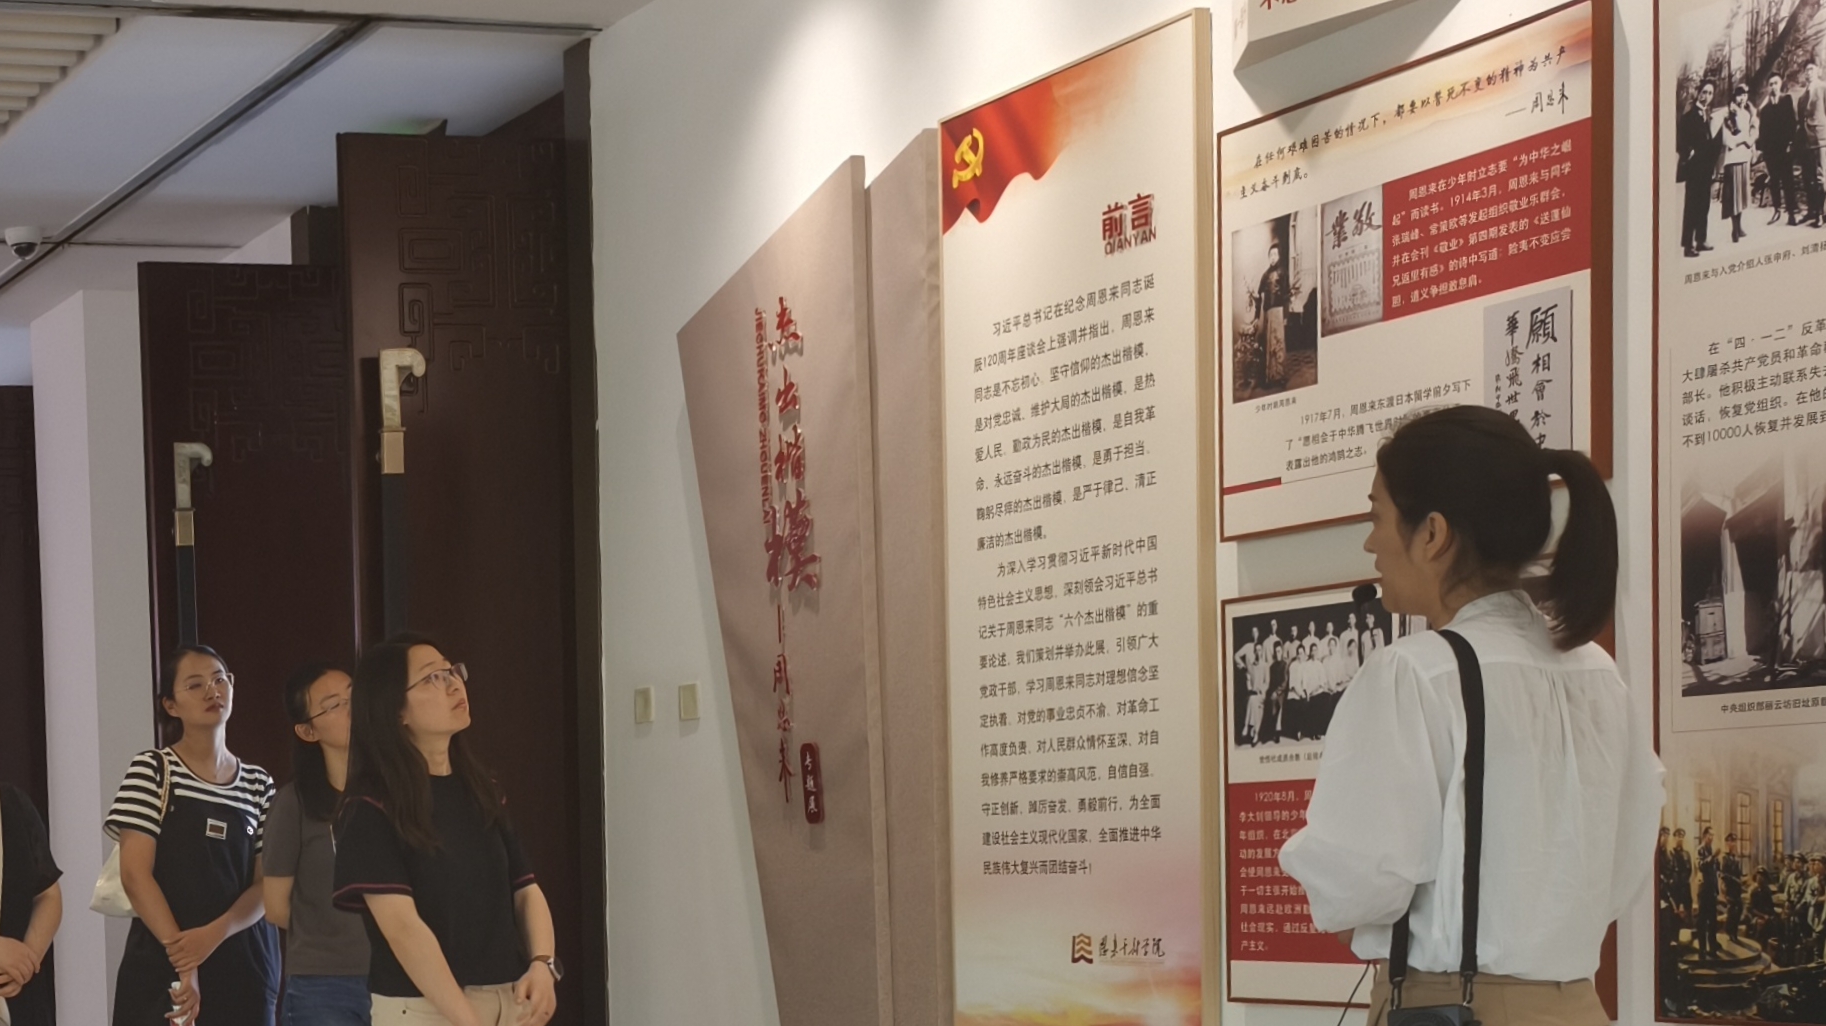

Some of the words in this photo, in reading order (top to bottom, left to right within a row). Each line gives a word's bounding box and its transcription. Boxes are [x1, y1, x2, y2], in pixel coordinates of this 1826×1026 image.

[1102, 193, 1152, 241] 前言
[1104, 226, 1156, 256] QIANYAN
[993, 273, 1155, 336] 习近平总书记在纪念周恩来同志诞
[1682, 341, 1826, 384] 大肆屠杀共产党员和革命
[977, 526, 1047, 551] 廉洁的杰出楷模。
[997, 535, 1157, 578] 为深入学习贯彻习近平新时代中国
[978, 600, 1158, 640] 记关于周恩来同志“六个杰出楷模”的重
[984, 860, 1092, 875] 民族伟大复兴而团结奋斗！
